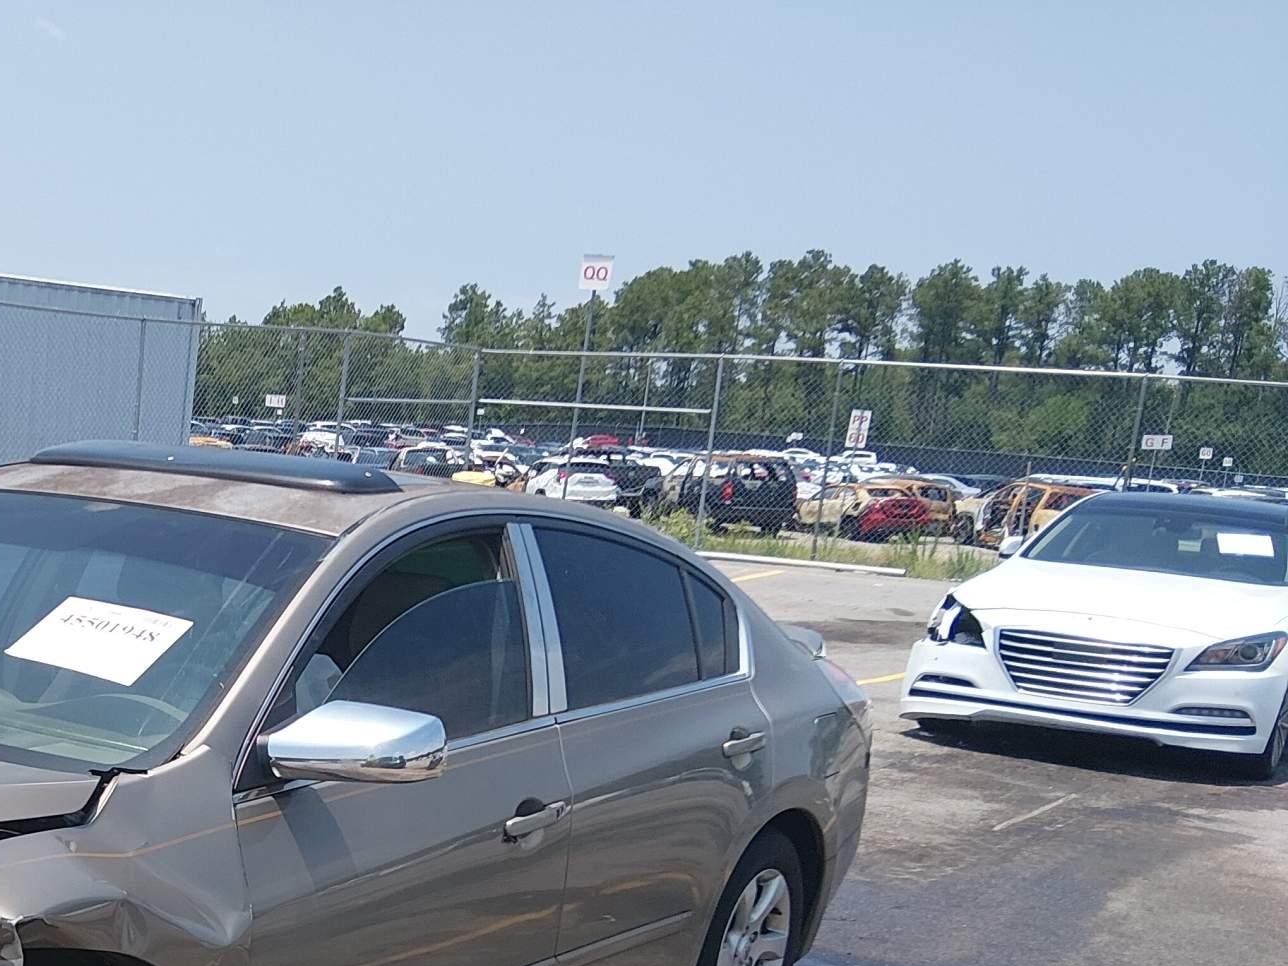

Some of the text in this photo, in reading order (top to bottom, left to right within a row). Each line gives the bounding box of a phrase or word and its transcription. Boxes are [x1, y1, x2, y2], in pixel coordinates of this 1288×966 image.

[583, 265, 609, 281] QQ
[852, 415, 869, 425] PP
[848, 432, 865, 444] 60
[60, 614, 160, 642] 45501948
